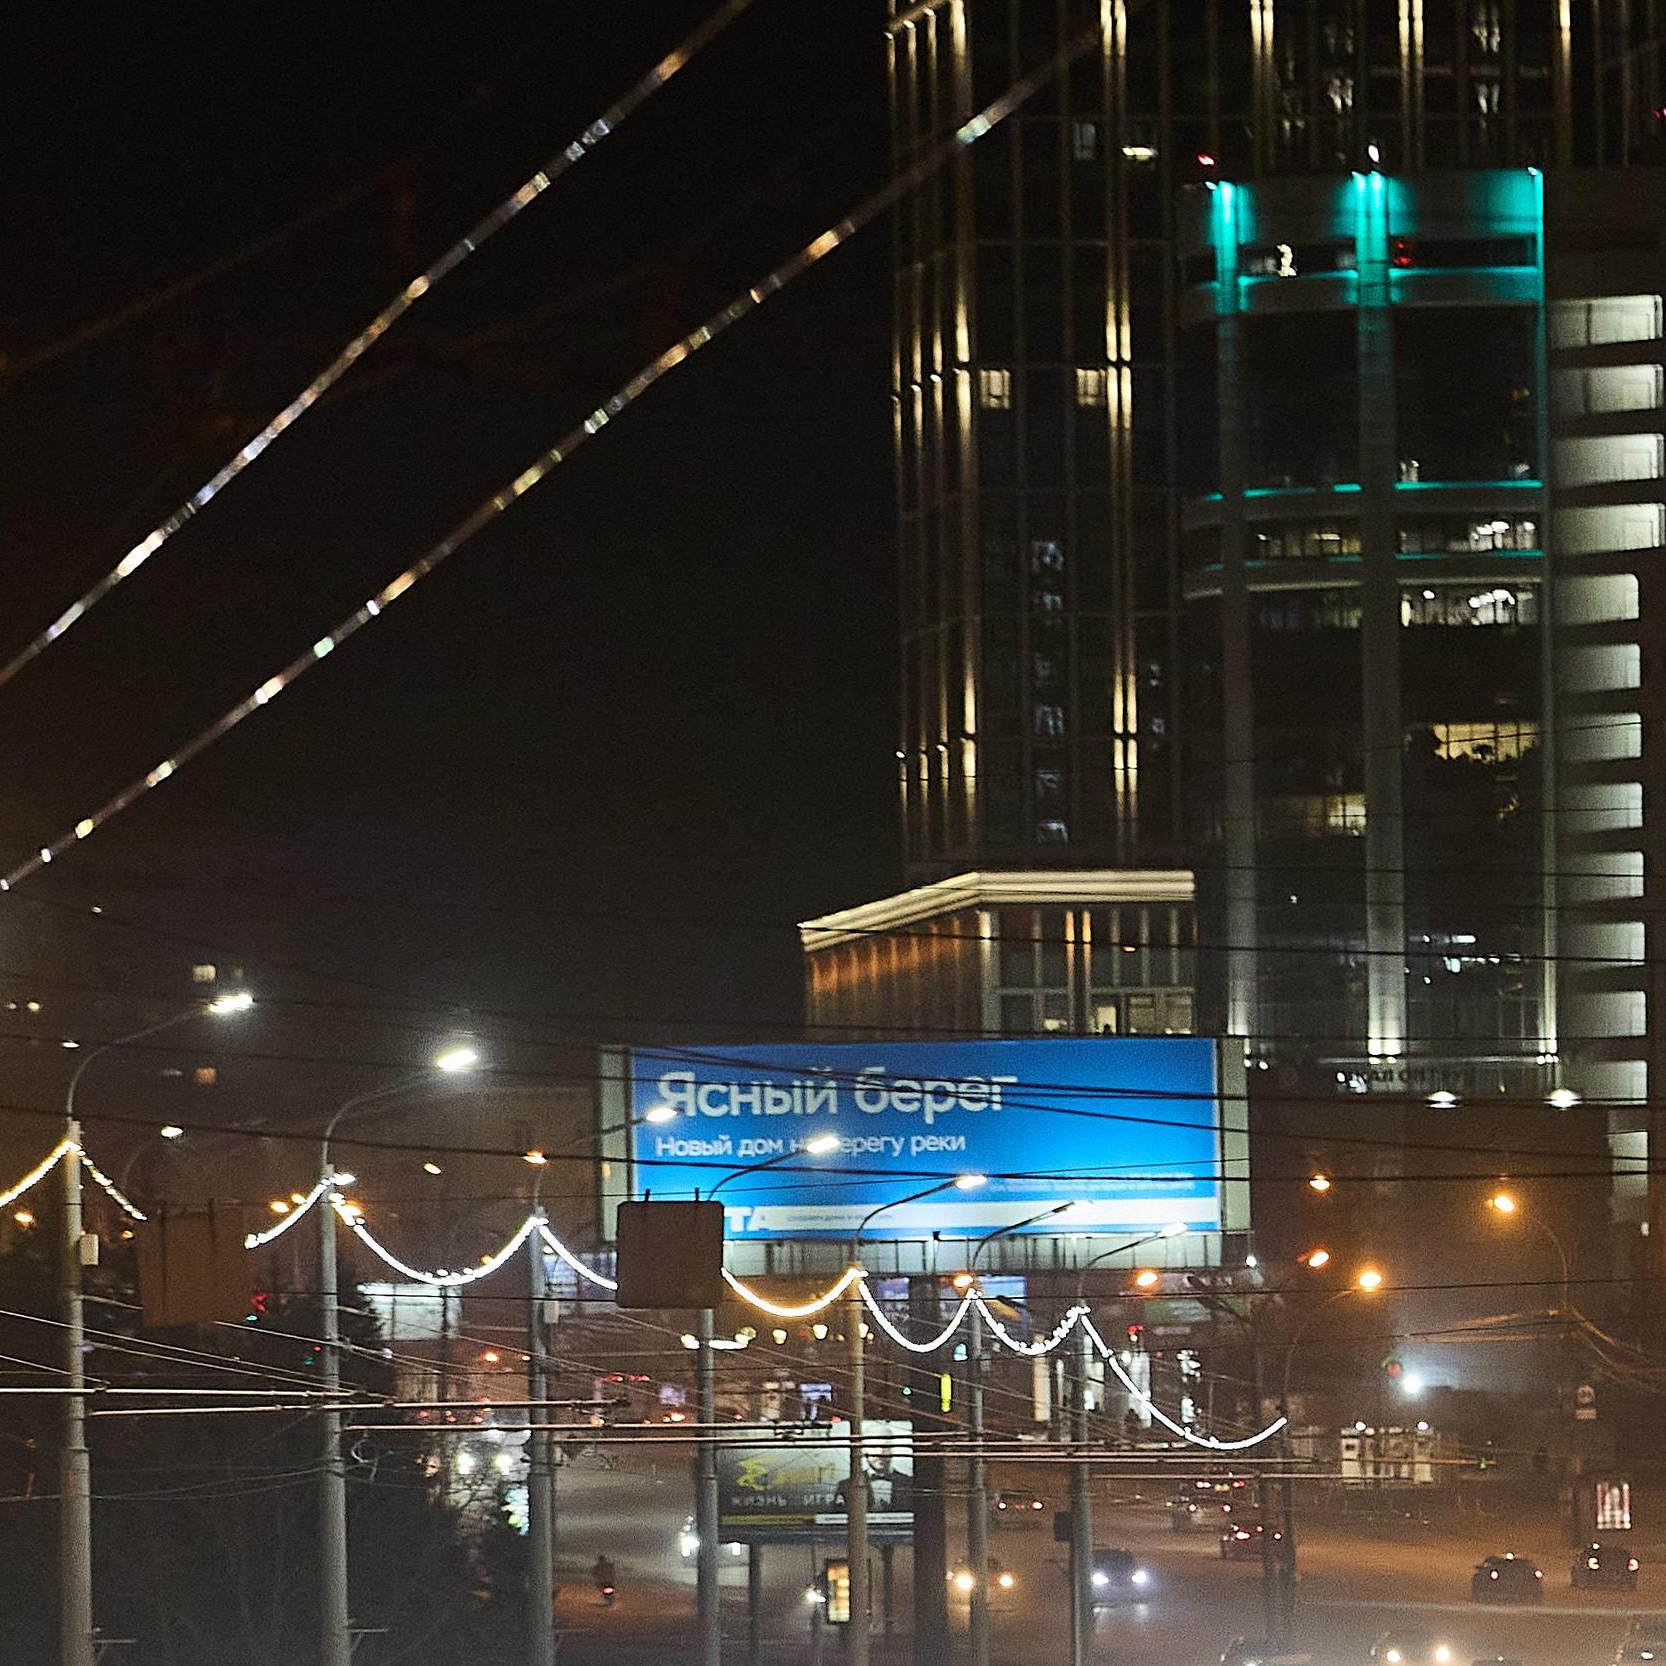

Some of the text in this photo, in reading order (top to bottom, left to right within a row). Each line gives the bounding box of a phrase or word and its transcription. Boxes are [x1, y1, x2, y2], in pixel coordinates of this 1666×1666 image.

[658, 1066, 1019, 1125] Ясный берег
[654, 1135, 733, 1157] Новый
[737, 1138, 784, 1158] дом
[835, 1136, 904, 1157] ерегу
[910, 1135, 966, 1156] реки
